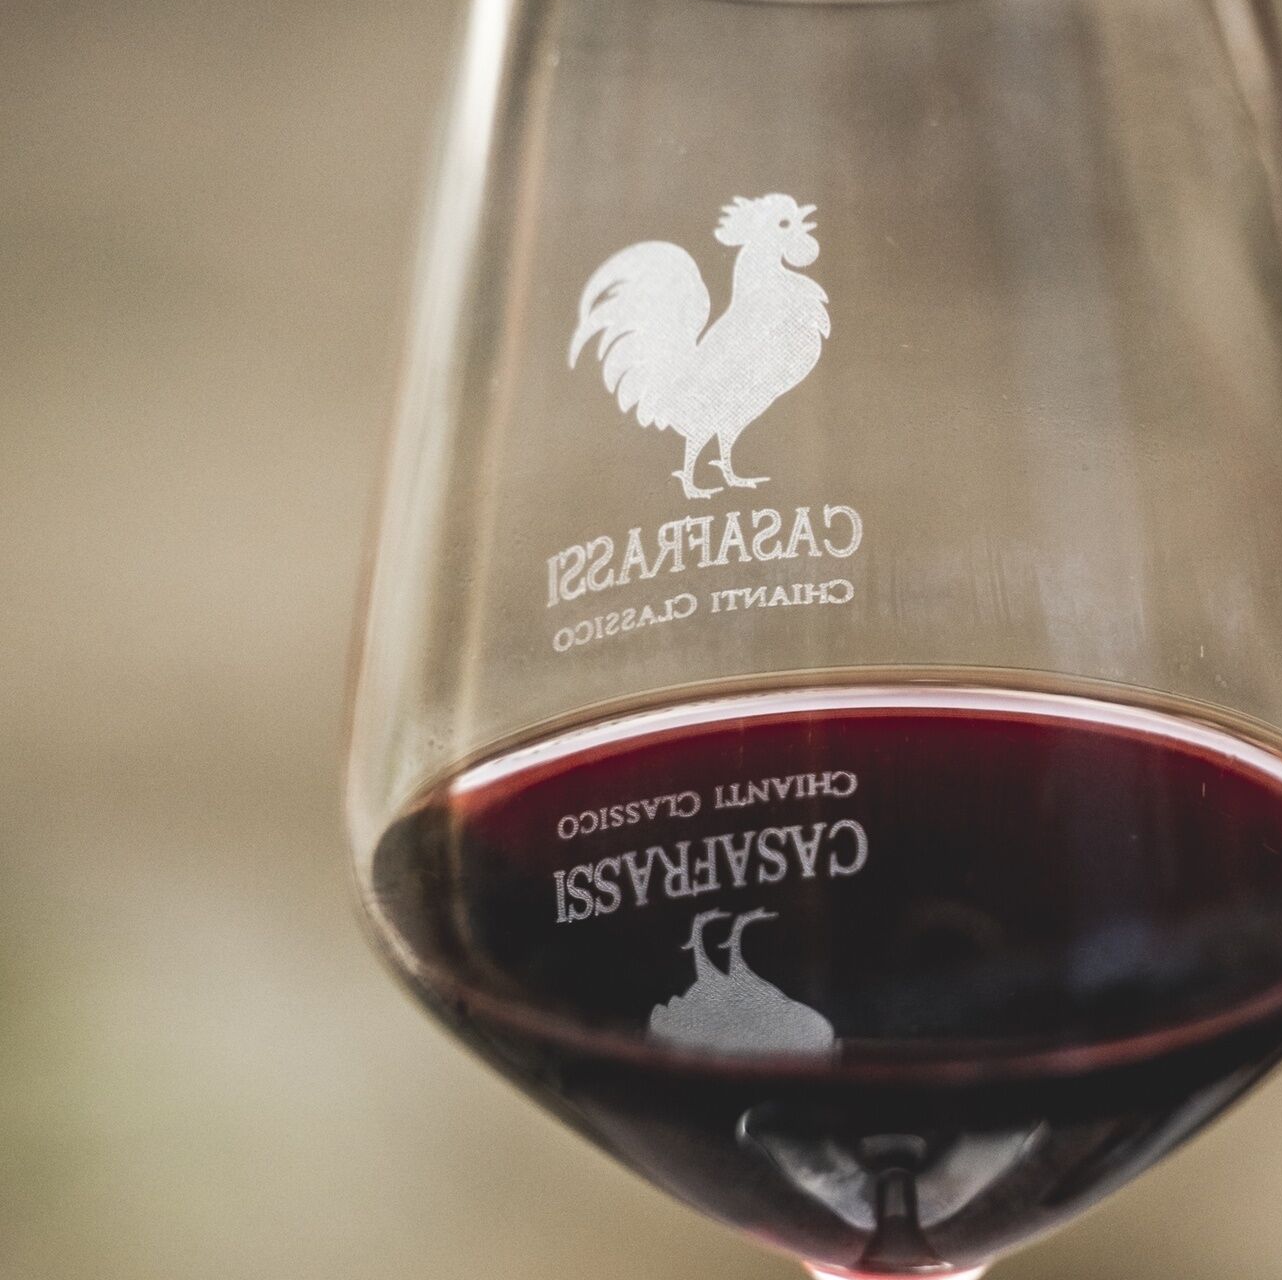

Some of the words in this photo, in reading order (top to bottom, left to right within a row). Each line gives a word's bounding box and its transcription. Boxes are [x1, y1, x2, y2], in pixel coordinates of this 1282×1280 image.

[715, 770, 859, 808] CHIANTI
[557, 791, 701, 840] CLASSICO
[552, 818, 869, 923] CASAFRASSI
